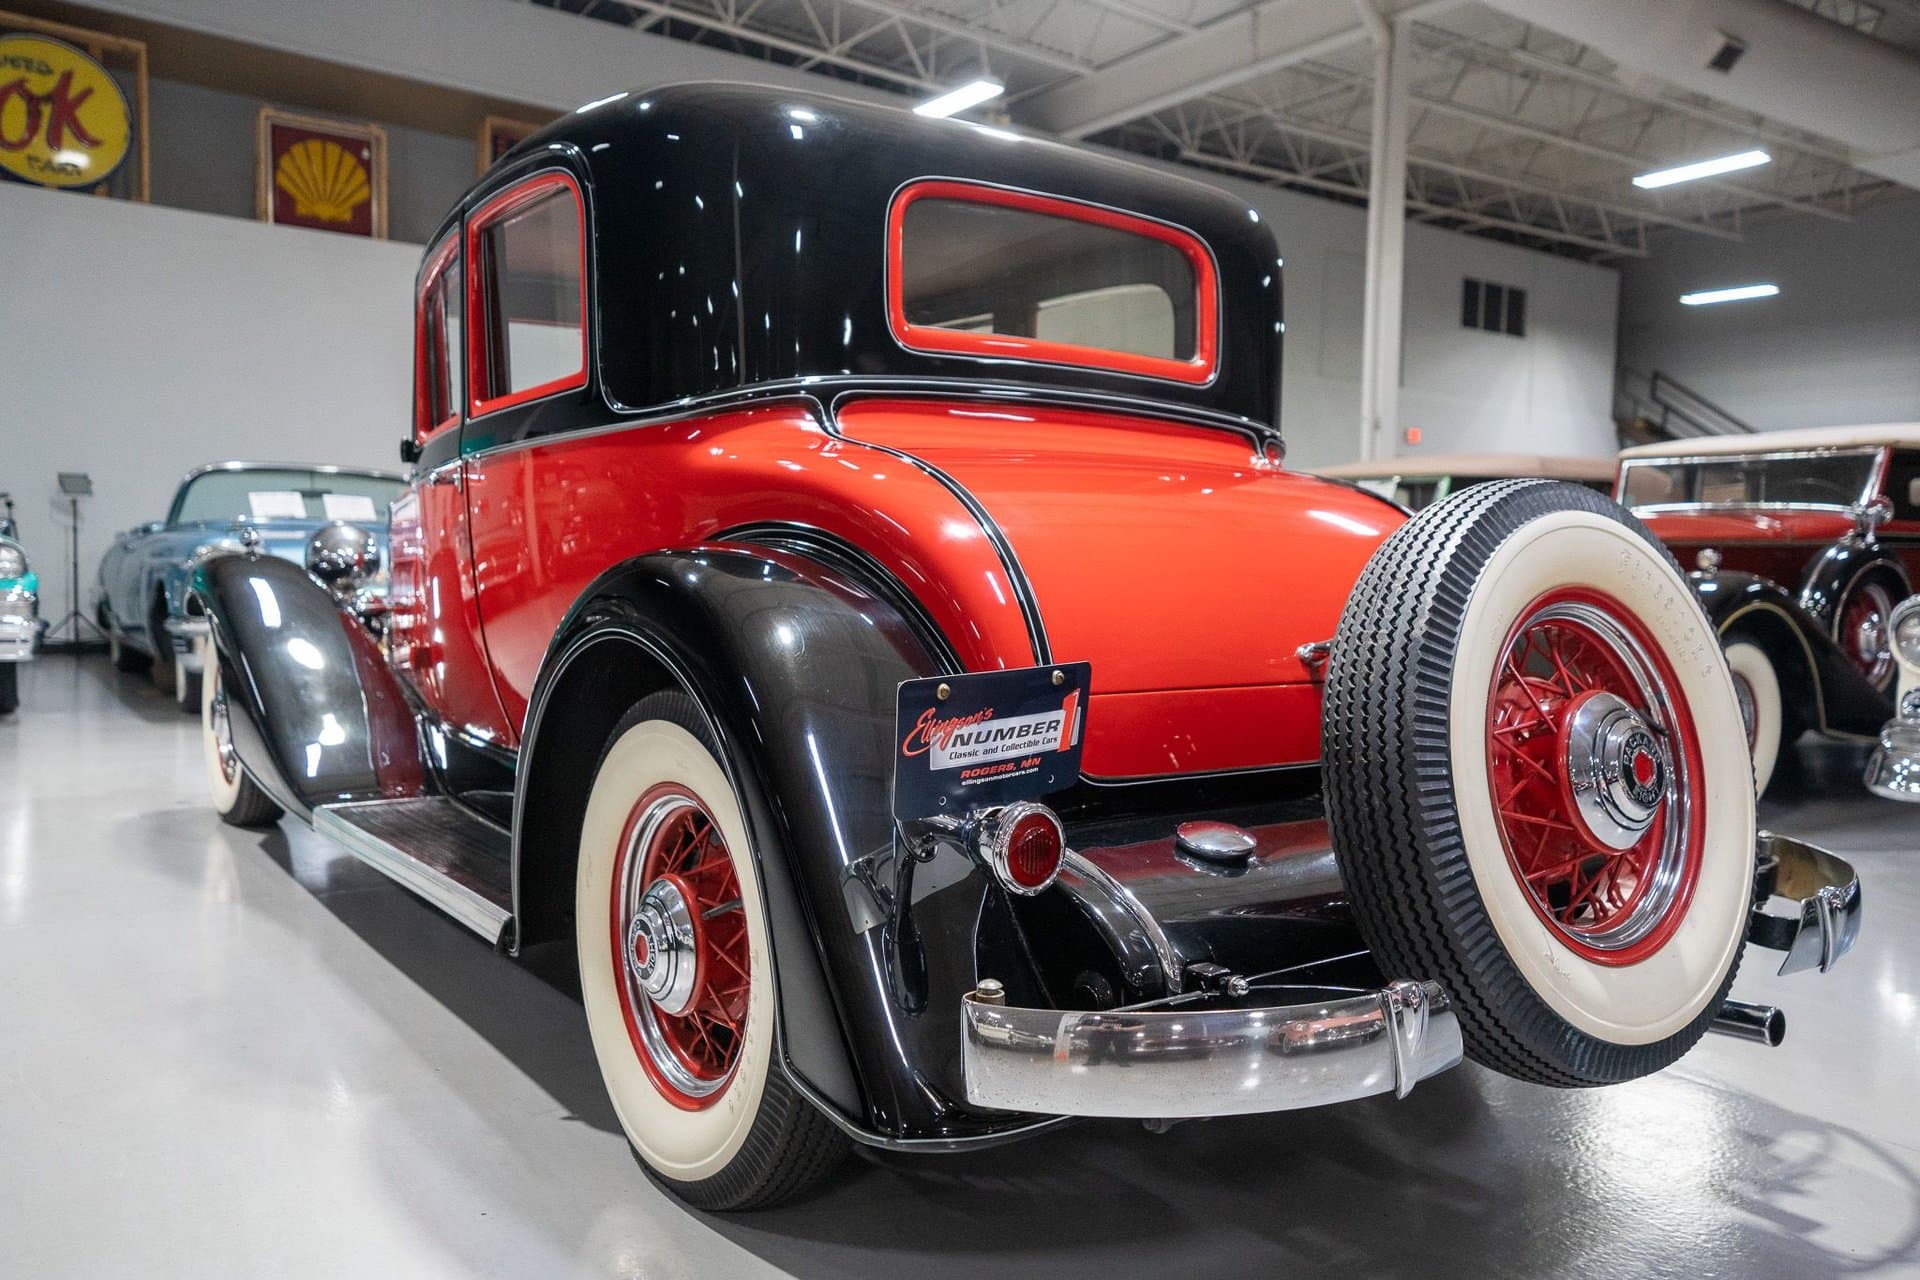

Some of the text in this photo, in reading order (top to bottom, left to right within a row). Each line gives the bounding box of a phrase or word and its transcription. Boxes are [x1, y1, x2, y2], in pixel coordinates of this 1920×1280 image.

[0, 68, 103, 151] OK
[902, 706, 993, 757] Ellingson's
[951, 688, 1081, 753] NUMBER 1
[949, 736, 1058, 760] Classic and Collectible Cars
[960, 757, 1042, 779] ROGERS, MN
